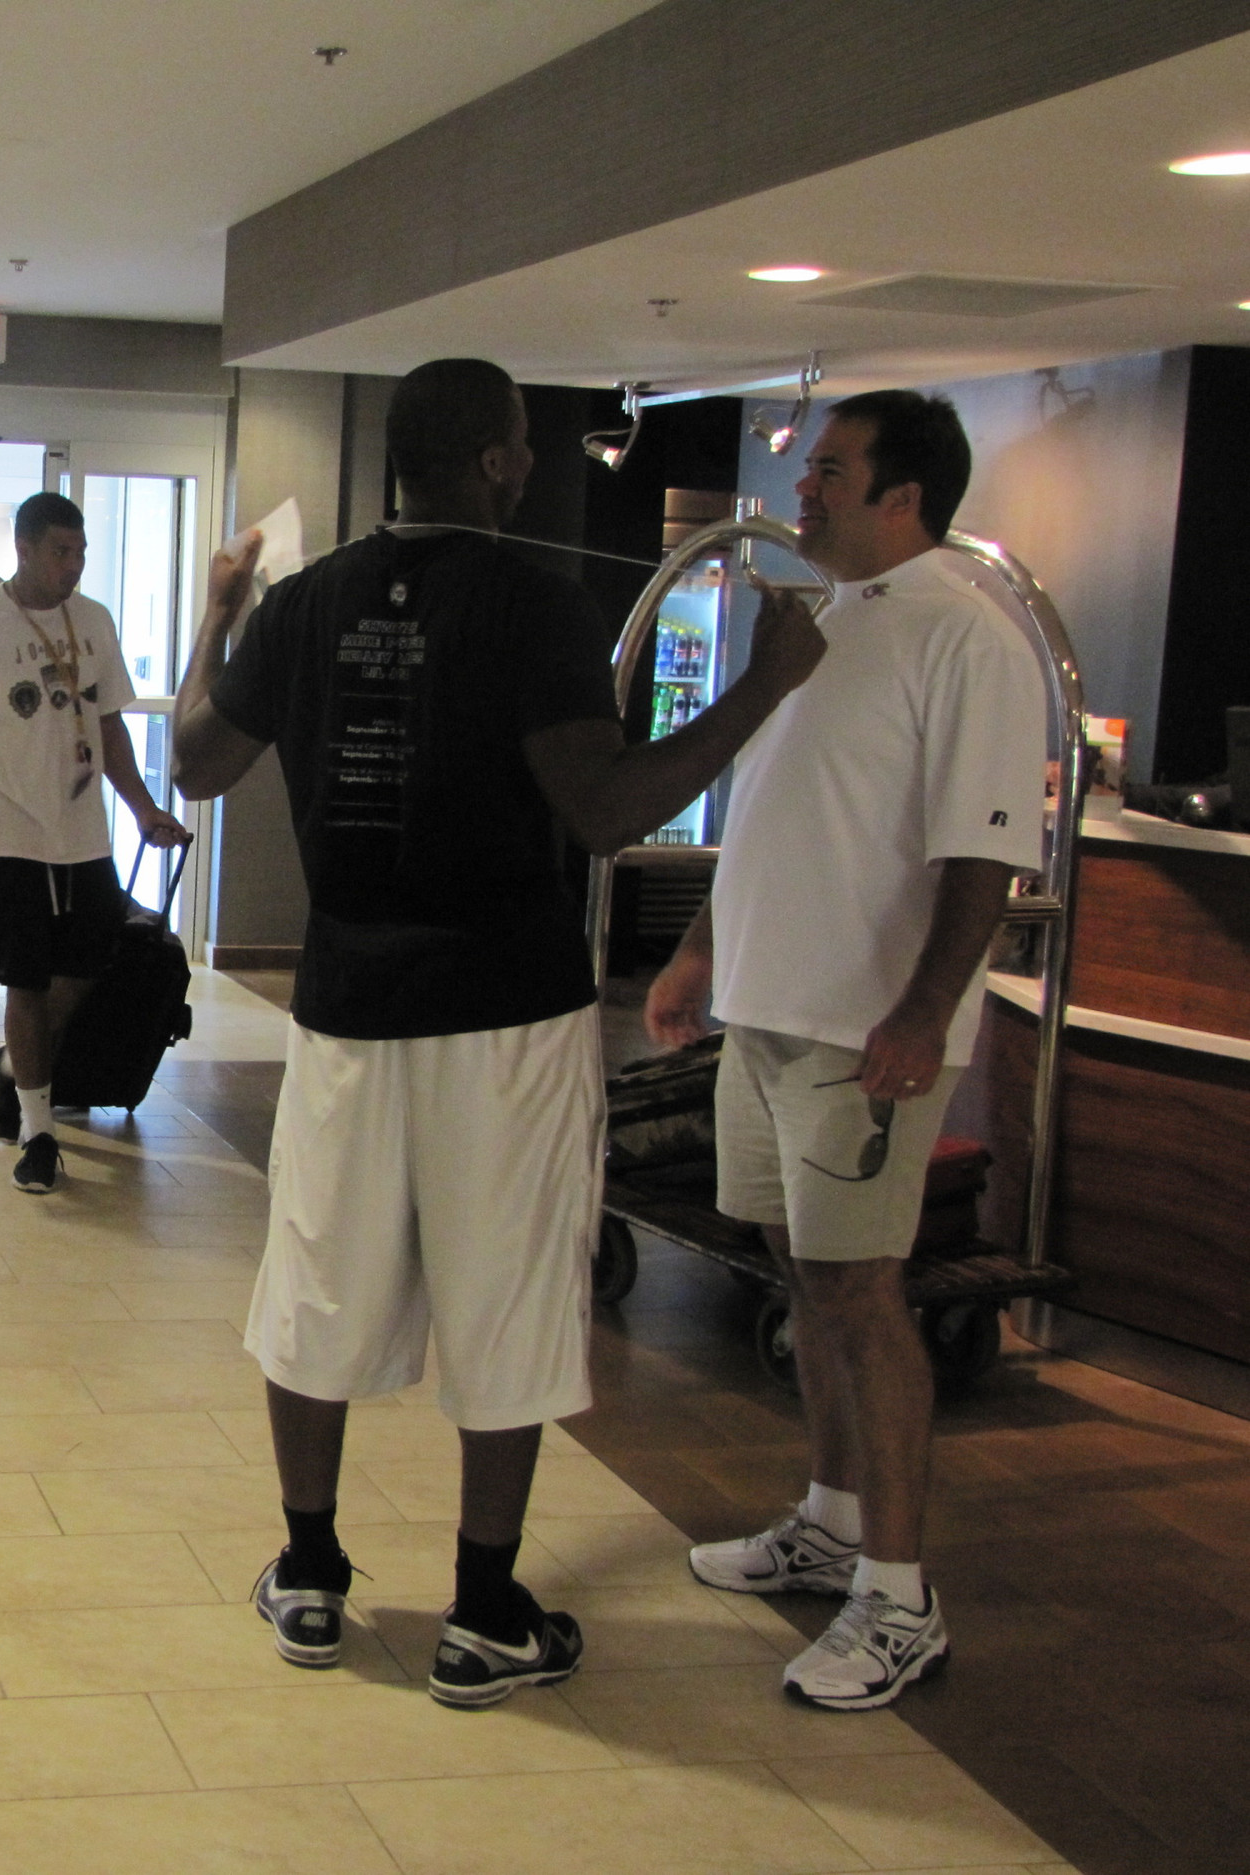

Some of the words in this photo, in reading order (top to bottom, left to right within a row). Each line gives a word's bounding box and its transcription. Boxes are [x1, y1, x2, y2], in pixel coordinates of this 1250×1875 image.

[345, 725, 388, 735] September
[341, 750, 383, 759] September
[339, 774, 380, 784] September
[300, 1611, 327, 1627] NIKE
[437, 1644, 466, 1666] NIKE
